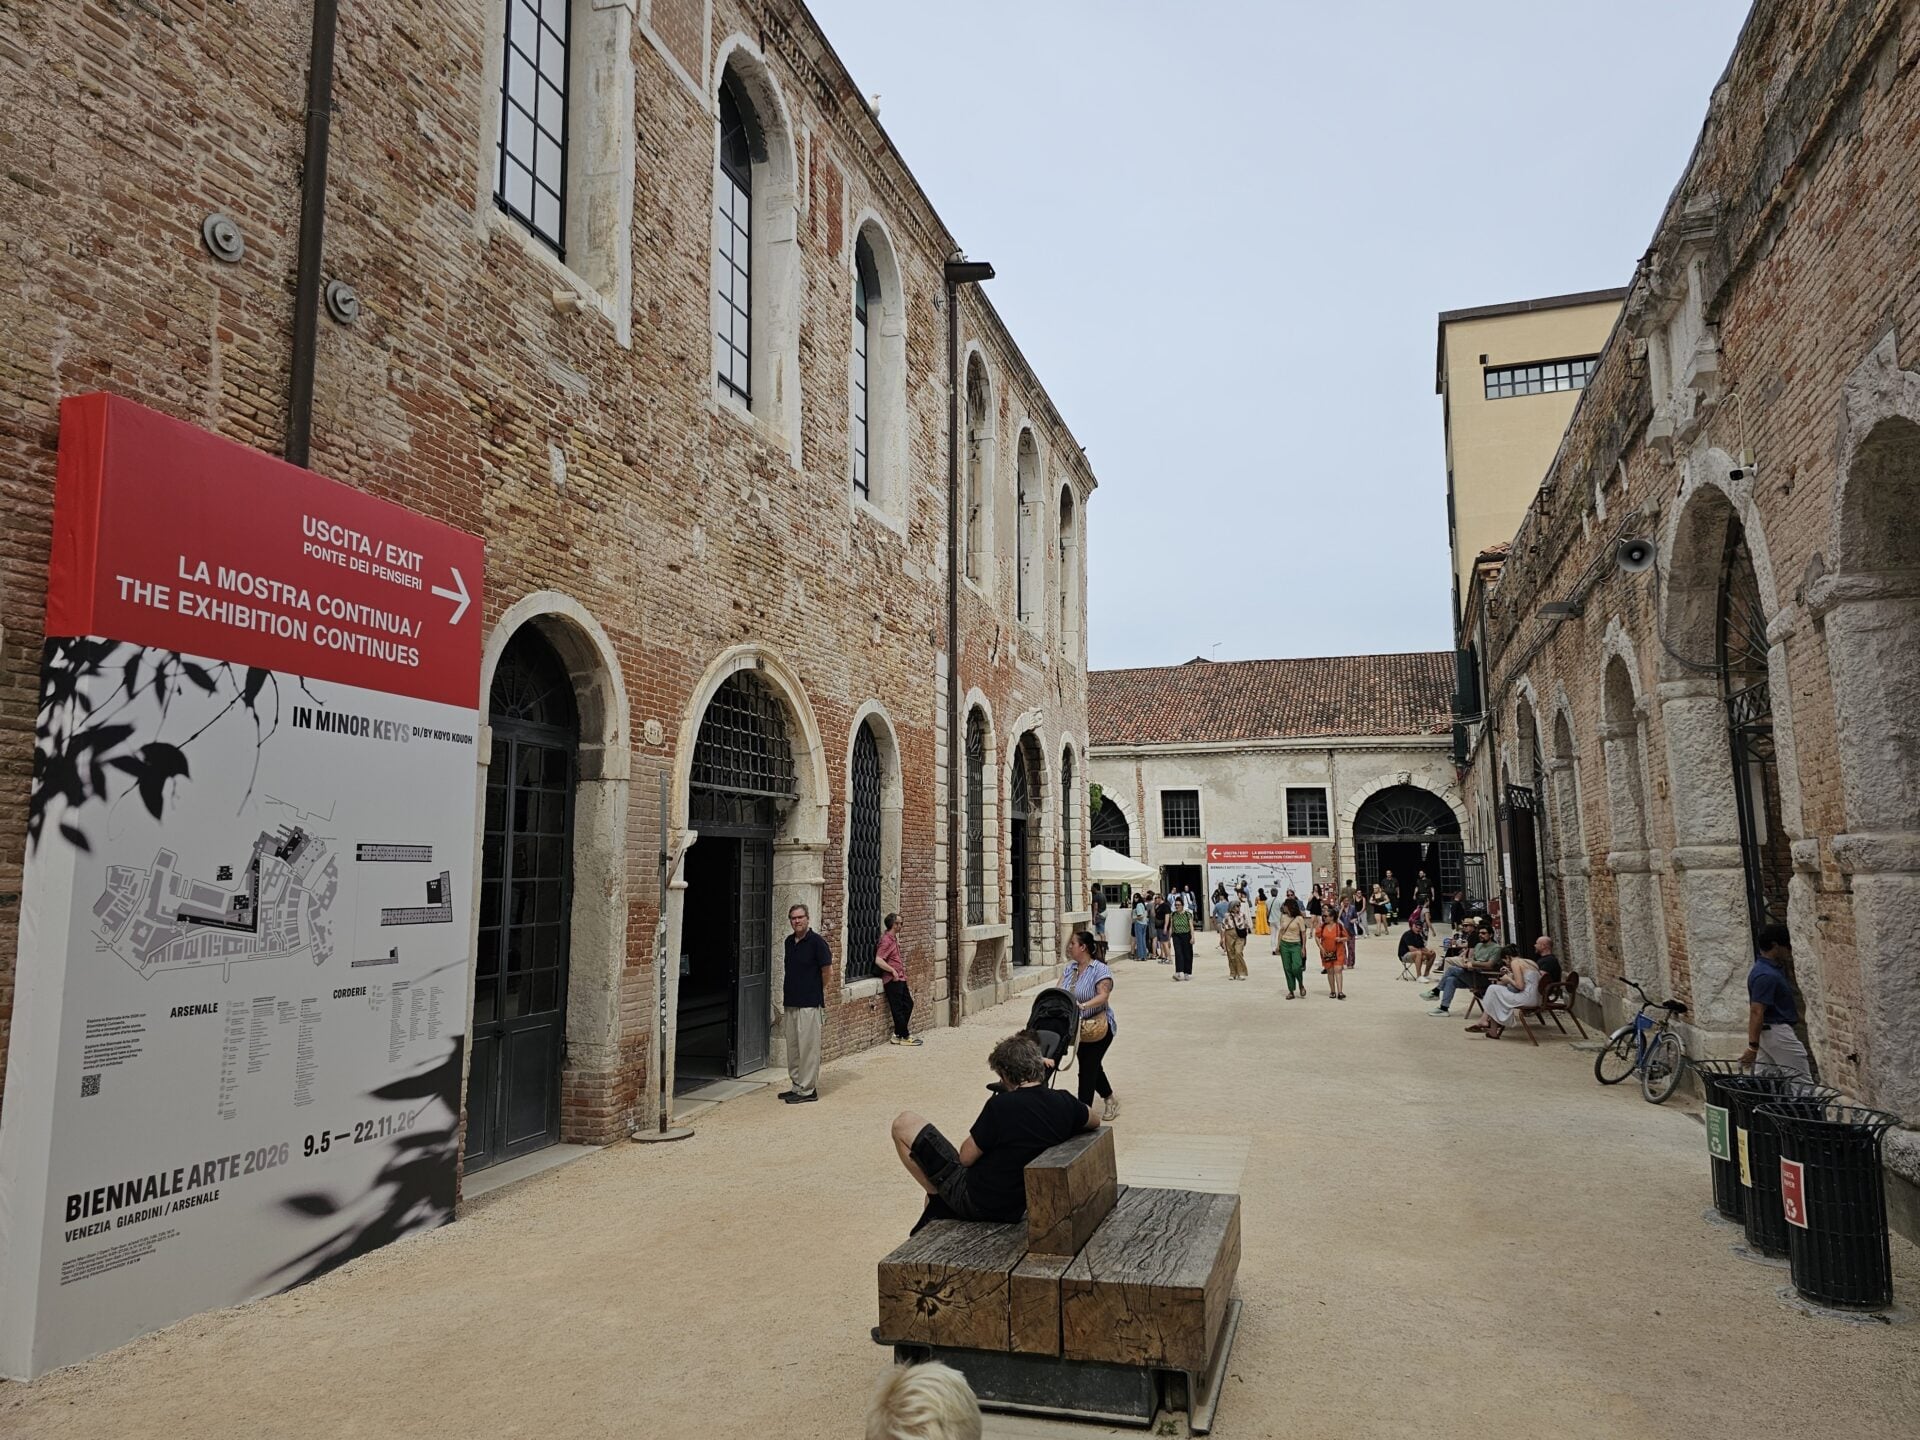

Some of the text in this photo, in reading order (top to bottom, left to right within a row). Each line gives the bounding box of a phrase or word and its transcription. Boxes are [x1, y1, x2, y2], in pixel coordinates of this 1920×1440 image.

[303, 515, 371, 556] USCITA
[386, 544, 423, 572] EXIT
[304, 542, 422, 590] PONTE DEI PENSIERI
[116, 575, 419, 667] THE EXHIBITION CONTINUES
[179, 555, 211, 585] LA
[218, 566, 311, 611] MOSTRA
[317, 595, 411, 637] CONTINUA
[293, 706, 312, 729] IN
[316, 710, 370, 737] MINOR
[373, 719, 410, 743] KEYS
[412, 727, 432, 739] DI/BY
[434, 729, 451, 741] KOYO
[170, 1002, 219, 1018] ARSENALE
[333, 986, 367, 999] CORDERIE
[304, 1130, 331, 1157] 9.5
[354, 1110, 415, 1144] 22.11.26
[65, 1142, 289, 1223] BIENNALE ARTE 2026
[65, 1219, 111, 1242] VENEZIA
[117, 1205, 162, 1228] GIARDINI
[172, 1189, 220, 1212] ARSENALE
